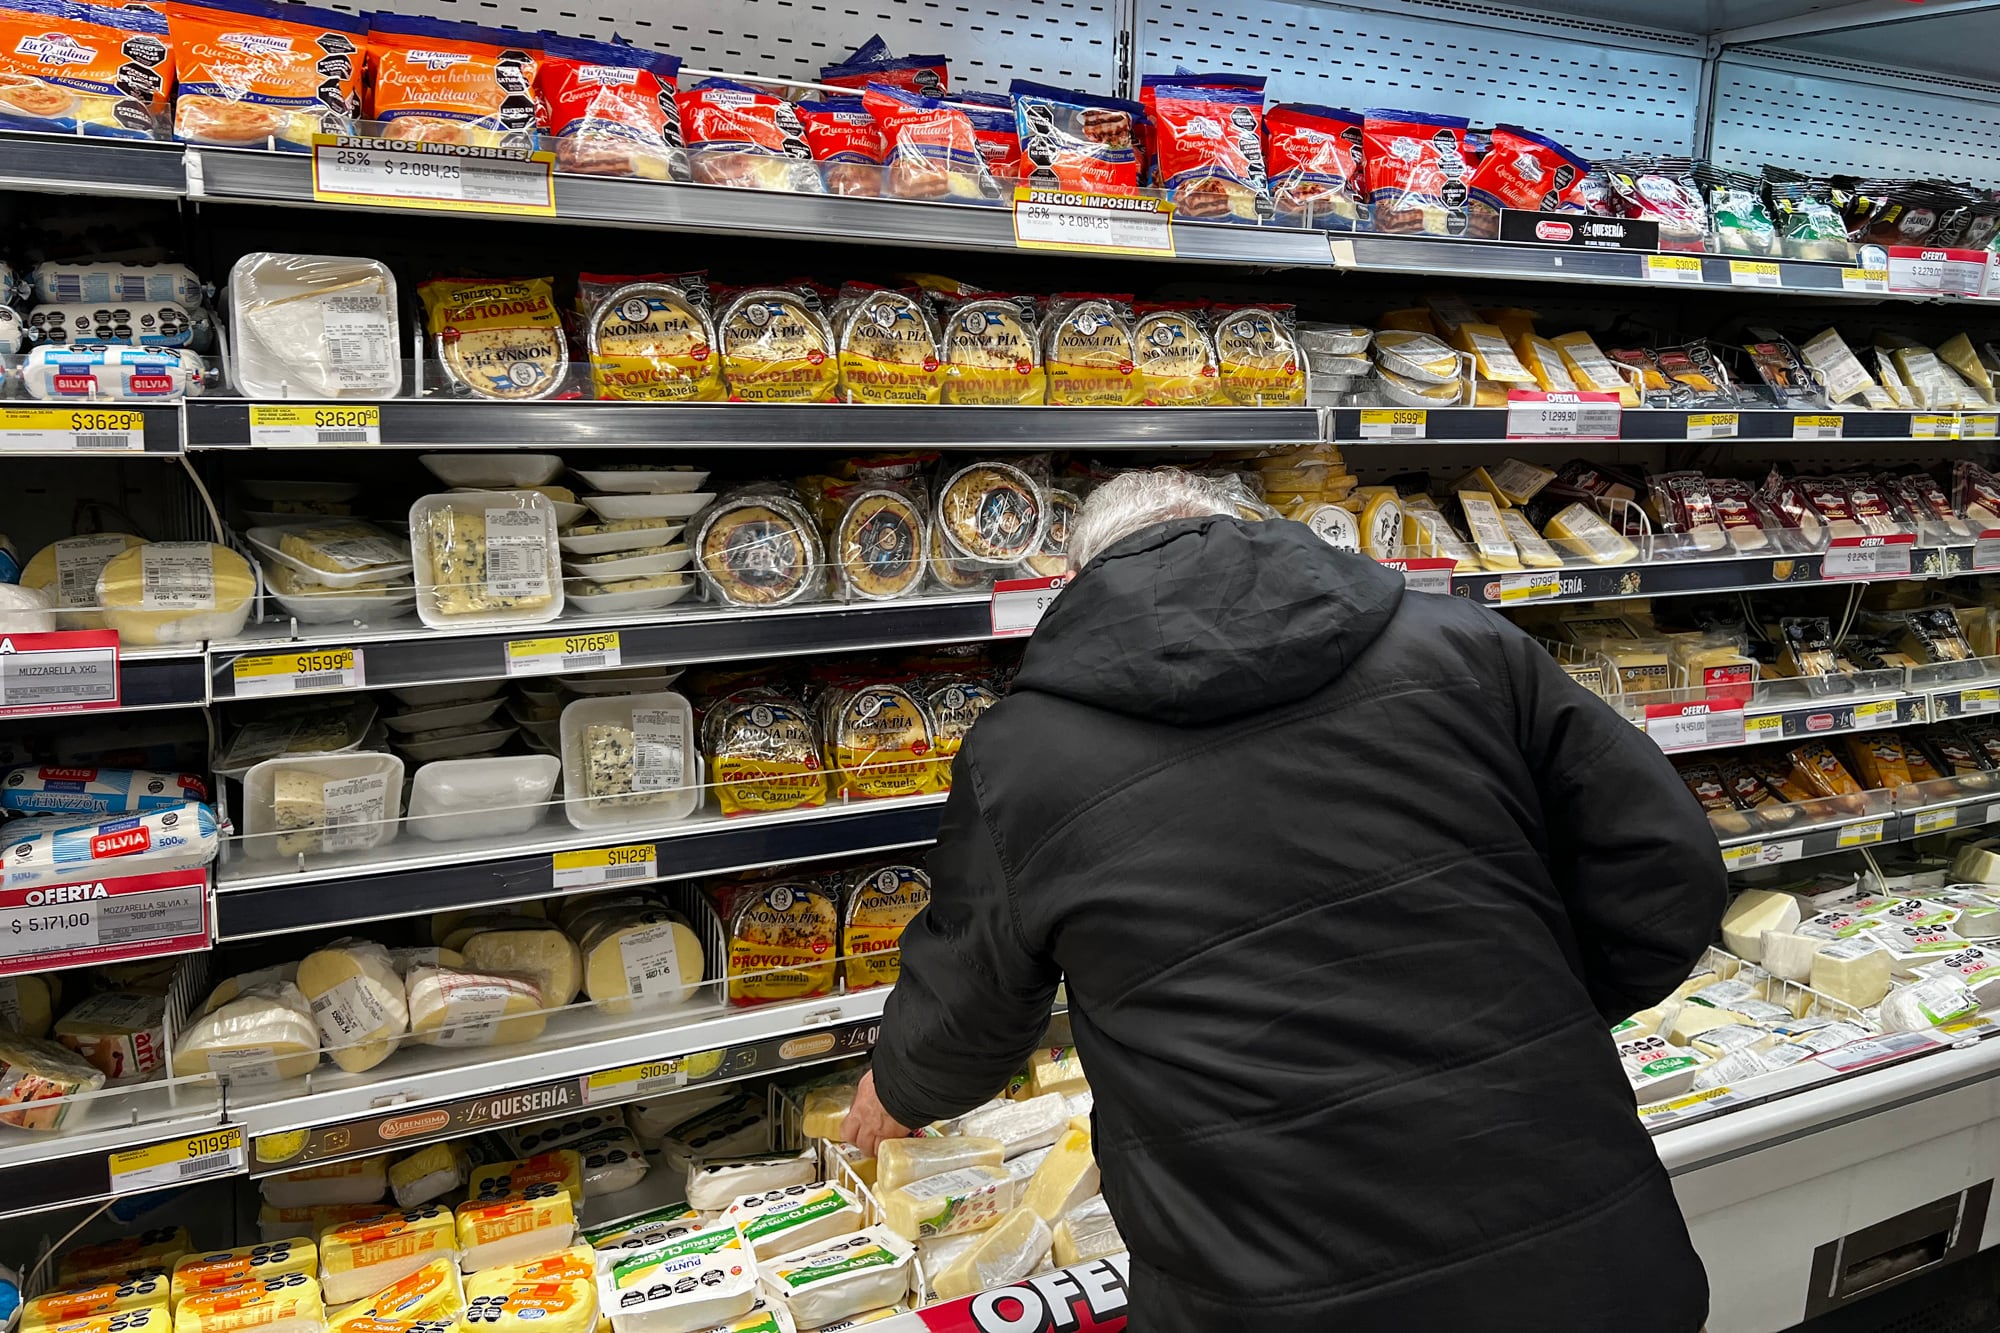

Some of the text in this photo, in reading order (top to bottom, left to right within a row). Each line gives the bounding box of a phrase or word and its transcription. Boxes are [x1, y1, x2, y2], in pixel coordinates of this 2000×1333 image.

[57, 77, 109, 93] REGGIANITO
[384, 67, 492, 87] Queso en hebras
[403, 86, 480, 105] Napolitano
[883, 116, 919, 131] Queso
[337, 136, 535, 163] PRECIOS IMPOSIBLES!
[337, 151, 371, 168] 25%
[384, 160, 394, 176] $
[399, 161, 461, 181] 2.084,25
[1029, 192, 1160, 213] PRECIOS IMPOSIBLES!
[1027, 207, 1050, 220] 25%
[1059, 214, 1110, 231] $ 2.084,25
[1591, 222, 1624, 238] QUESERÍA
[1921, 251, 1947, 261] OFERTA
[443, 295, 549, 323] PROVOLETA
[604, 317, 689, 338] NONNA PÍA
[782, 324, 806, 338] PÍA
[907, 327, 927, 343] PÍA
[997, 331, 1019, 345] PÍA
[1060, 333, 1122, 347] NONNA PÍA
[496, 345, 552, 363] NONNA
[1142, 343, 1201, 360] NONNA PÍA
[604, 364, 712, 388] PROVOLETA
[726, 368, 824, 385] PROVOLETA
[847, 369, 939, 389] PROVOLETA
[1054, 376, 1134, 392] PROVOLETA
[134, 379, 169, 390] SILVIA
[622, 383, 699, 400] Con Cazuela
[740, 387, 813, 401] Con Cazuela
[861, 386, 928, 402] Con Cazuela
[1546, 393, 1582, 404] OFERTA
[1541, 410, 1547, 422] $
[1859, 537, 1885, 548] OFERTA
[1558, 576, 1583, 594] SERÍA
[18, 664, 97, 678] MUZZARELLA XKG
[1681, 705, 1711, 716] OFERTA
[892, 714, 913, 729] PÍA
[785, 726, 807, 742] PÍA
[44, 767, 92, 778] SILVIA
[722, 770, 821, 789] PROVOLETA
[873, 777, 917, 790] Cazuela
[16, 794, 109, 813] MOZZARELLA
[737, 789, 759, 802] Con
[95, 831, 145, 852] SILVIA
[26, 882, 110, 906] OFERTA
[860, 890, 929, 910] NONNA PÍA
[103, 898, 189, 915] MOZZARELLA SILVIA X
[131, 909, 166, 921] 500 GRM
[747, 910, 820, 924] NONNA PÍA
[11, 912, 90, 935] $ 5.171,00
[865, 957, 886, 970] Con
[743, 971, 810, 984] Con Cazuela
[464, 1084, 569, 1124] La QUESERÍA
[767, 1200, 800, 1214] PUNTA
[186, 1259, 245, 1274] Por Salut
[664, 1258, 703, 1275] PUNTA
[46, 1290, 109, 1308] Por Salut
[194, 1286, 257, 1305] Por Salut
[383, 1277, 437, 1312] Por Salut
[971, 1260, 1128, 1333] OFE
[513, 1297, 566, 1311] Por Salut
[351, 1321, 404, 1333] Por Salut
